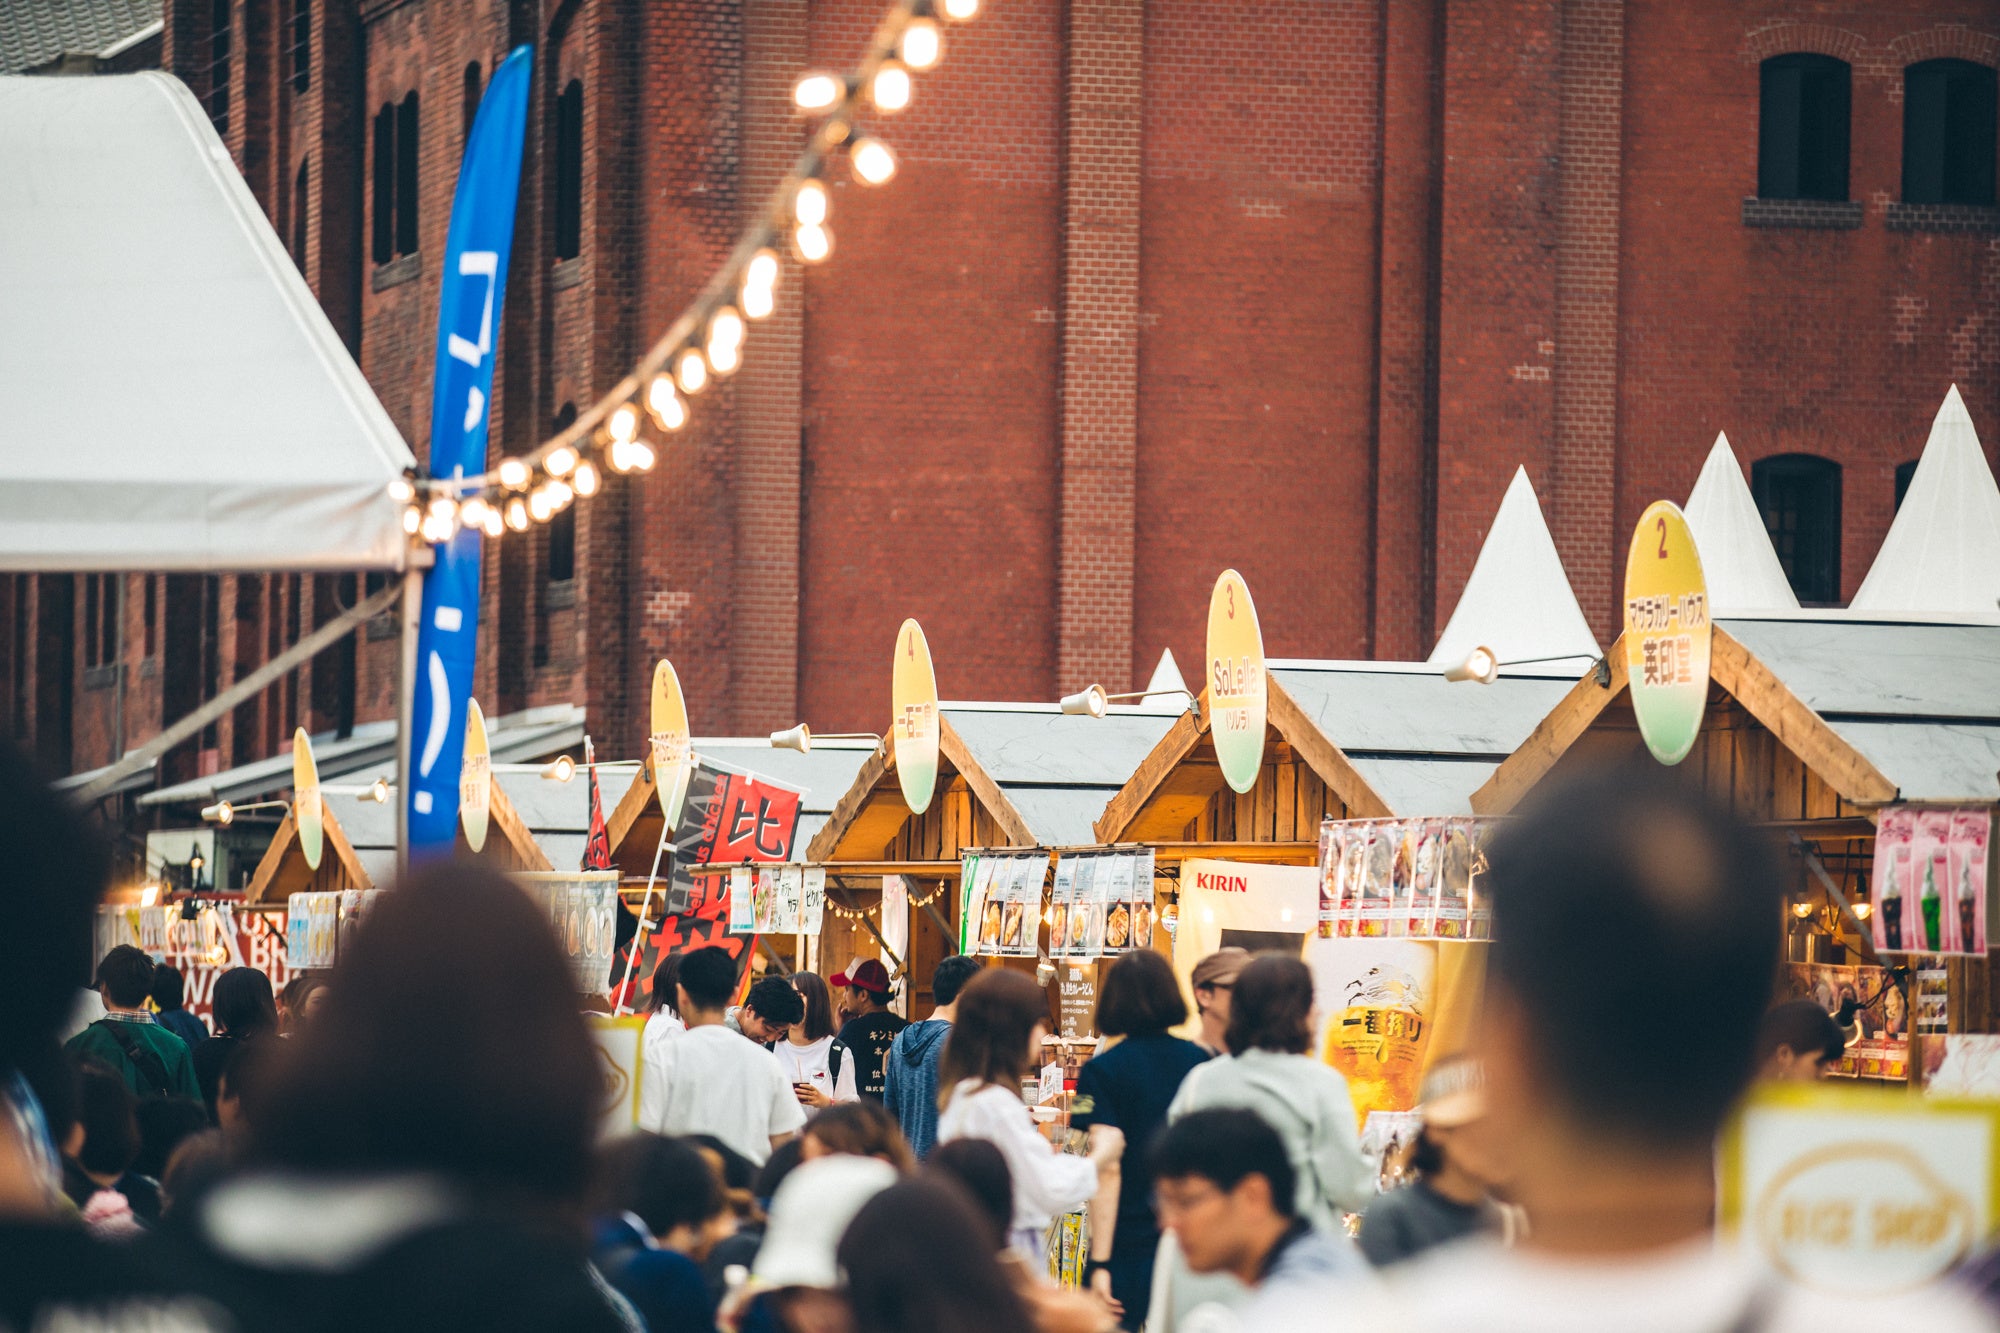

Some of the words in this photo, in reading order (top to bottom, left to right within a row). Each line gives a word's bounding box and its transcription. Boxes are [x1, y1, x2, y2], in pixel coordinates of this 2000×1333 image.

[1656, 516, 1668, 560] 2
[1226, 583, 1235, 620] 3
[1628, 596, 1706, 631] マサラカリーハウス
[907, 631, 914, 662] 4
[1643, 638, 1693, 686] 英印堂
[1214, 658, 1258, 697] SoLella
[701, 774, 728, 843] chicken
[1196, 872, 1248, 893] KIRIN
[1343, 1010, 1422, 1042] 一番搾り
